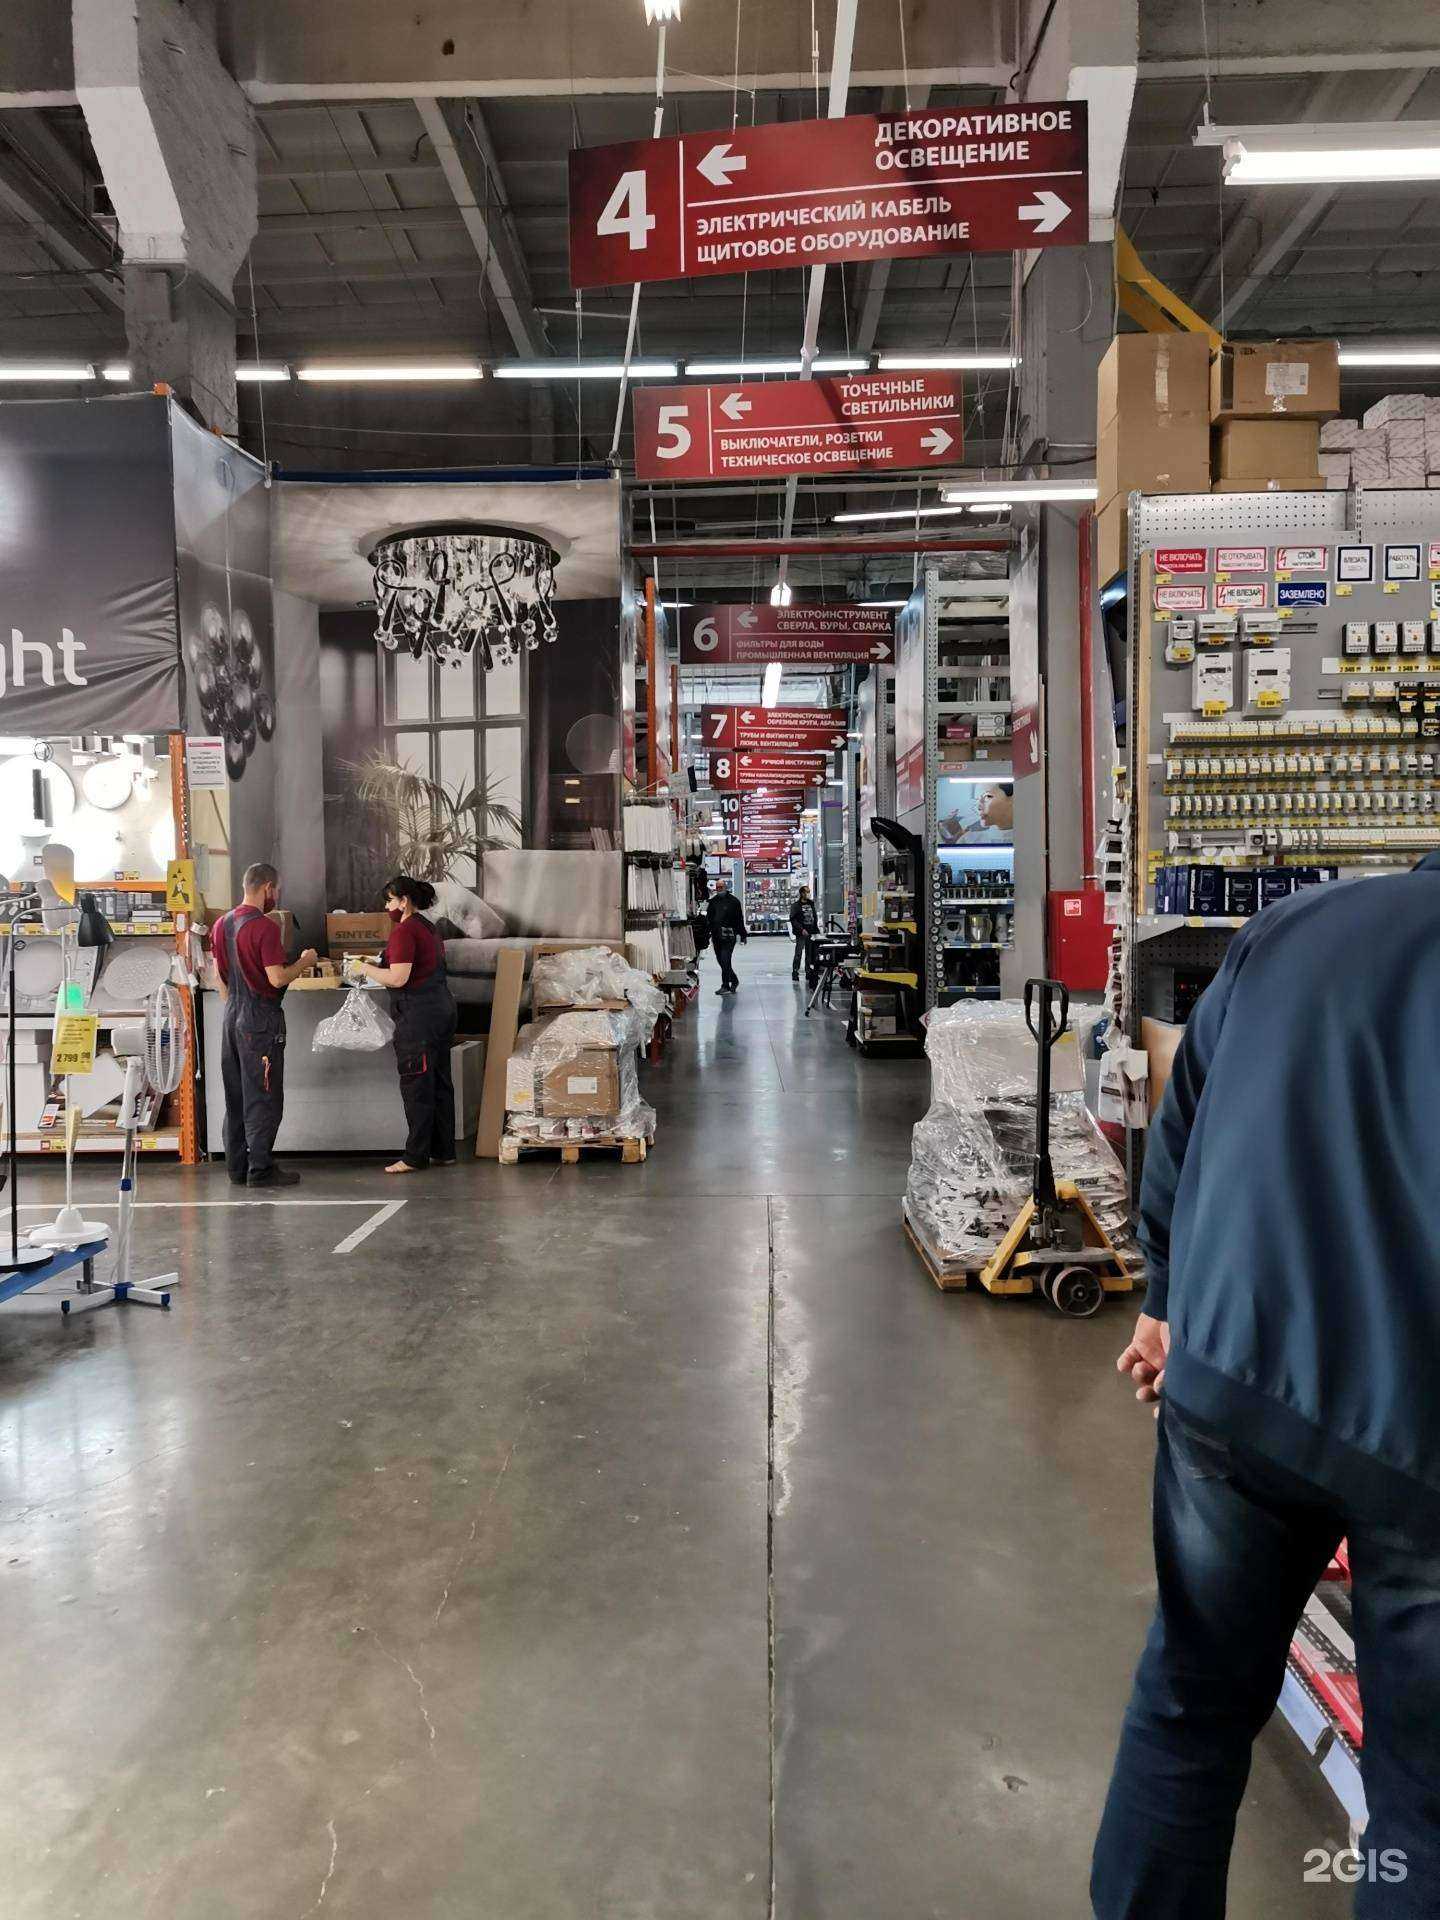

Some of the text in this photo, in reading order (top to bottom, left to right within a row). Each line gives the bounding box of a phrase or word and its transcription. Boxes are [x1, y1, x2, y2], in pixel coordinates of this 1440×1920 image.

[874, 110, 1072, 147] ДЕКОРАТИВНОЕ
[875, 140, 1029, 171] ОСВЕЩЕНИЕ
[597, 170, 656, 251] 4
[696, 197, 952, 236] ЭЛЕКТРИЧЕСКИЙ КАБЕЛЬ
[697, 222, 970, 264] ЩИТОВОЕ ОБОРУДОВАНИЕ
[840, 379, 925, 398] ТОЧЕЧНЫЕ
[841, 395, 954, 415] СВЕТИЛЬНИКИ
[656, 405, 692, 459] 5
[720, 430, 883, 451] ВЫКЛЮЧАТЕЛИ, РОЗЕТКИ
[720, 447, 893, 468] ТЕХНИЧЕСКОЕ ОСВЕЩЕНИЕ
[1279, 589, 1325, 599] ЗАЗЕМЛЕНО
[776, 609, 889, 620] ЭЛЕКТРОИНСТРУМЕНТ
[693, 617, 719, 651] 6
[776, 620, 892, 632] СВЕРЛА, БУРЫ, СВАРКА
[736, 639, 824, 649] ФИЛЬТРЫ ДЛЯ ВОДЫ
[736, 651, 870, 660] ПРОМЫШЛЕННАЯ ВЕНТИЛЯЦИЯ
[710, 714, 728, 739] 7
[716, 758, 731, 779] 8
[720, 798, 739, 813] 10
[723, 818, 739, 831] 11
[725, 834, 740, 846] 12
